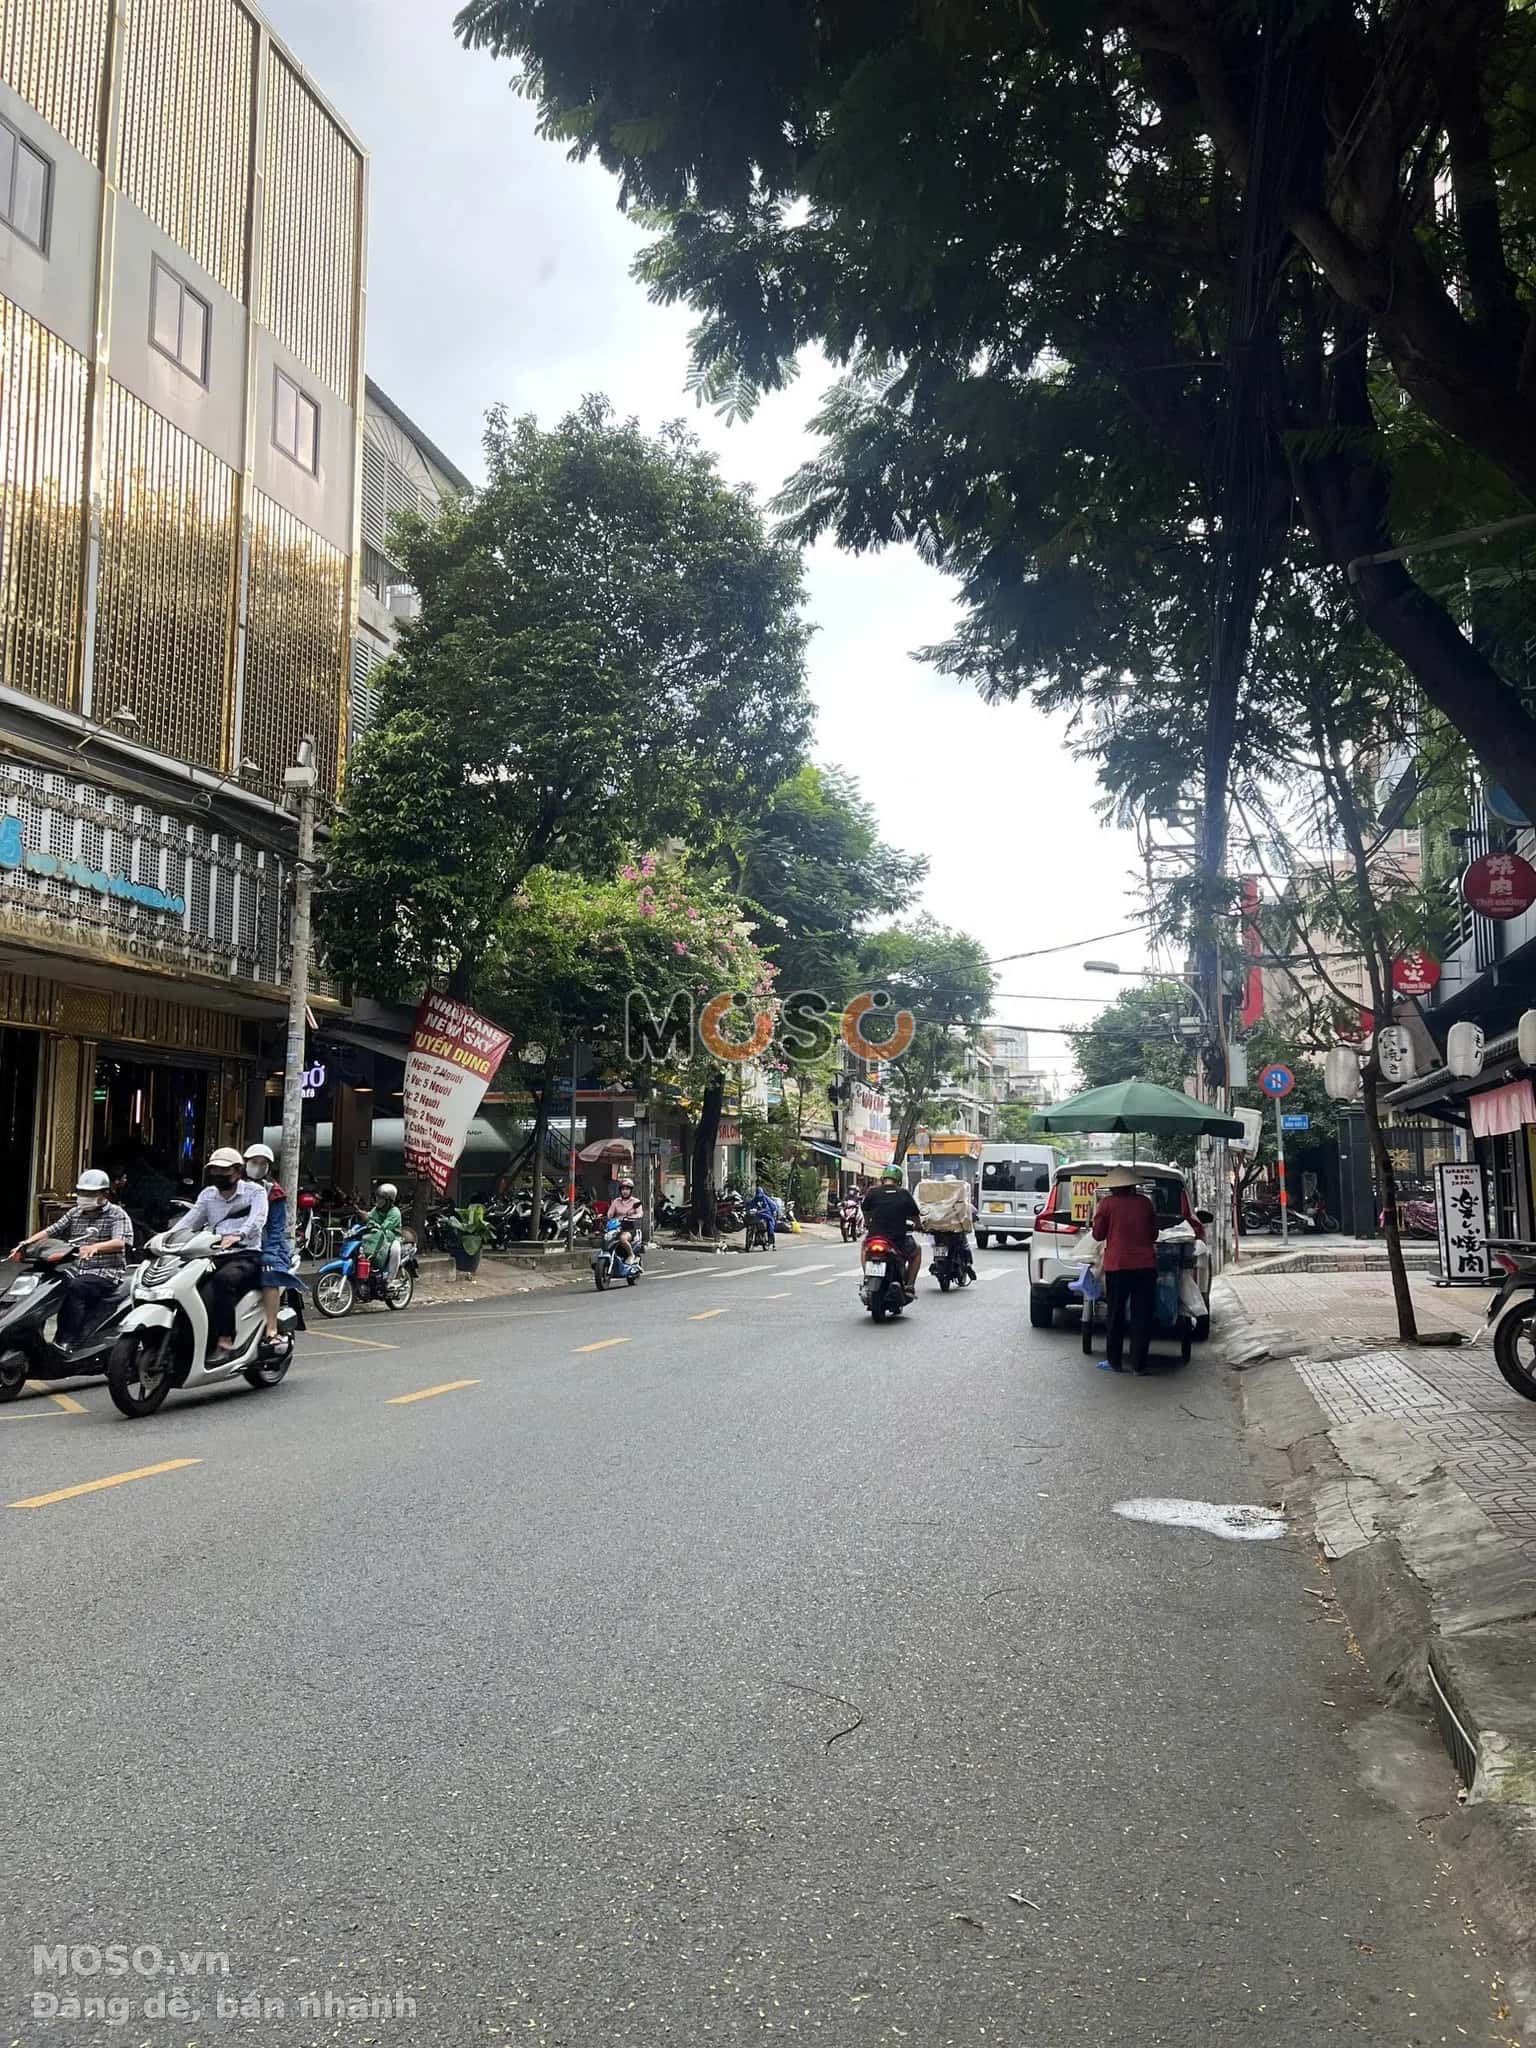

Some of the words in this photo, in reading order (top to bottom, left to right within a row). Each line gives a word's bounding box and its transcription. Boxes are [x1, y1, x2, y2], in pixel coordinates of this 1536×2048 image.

[424, 1012, 461, 1038] NEW
[463, 1031, 494, 1053] SKY
[423, 1078, 430, 1089] 5
[1450, 1187, 1484, 1274] 楽しい焼肉
